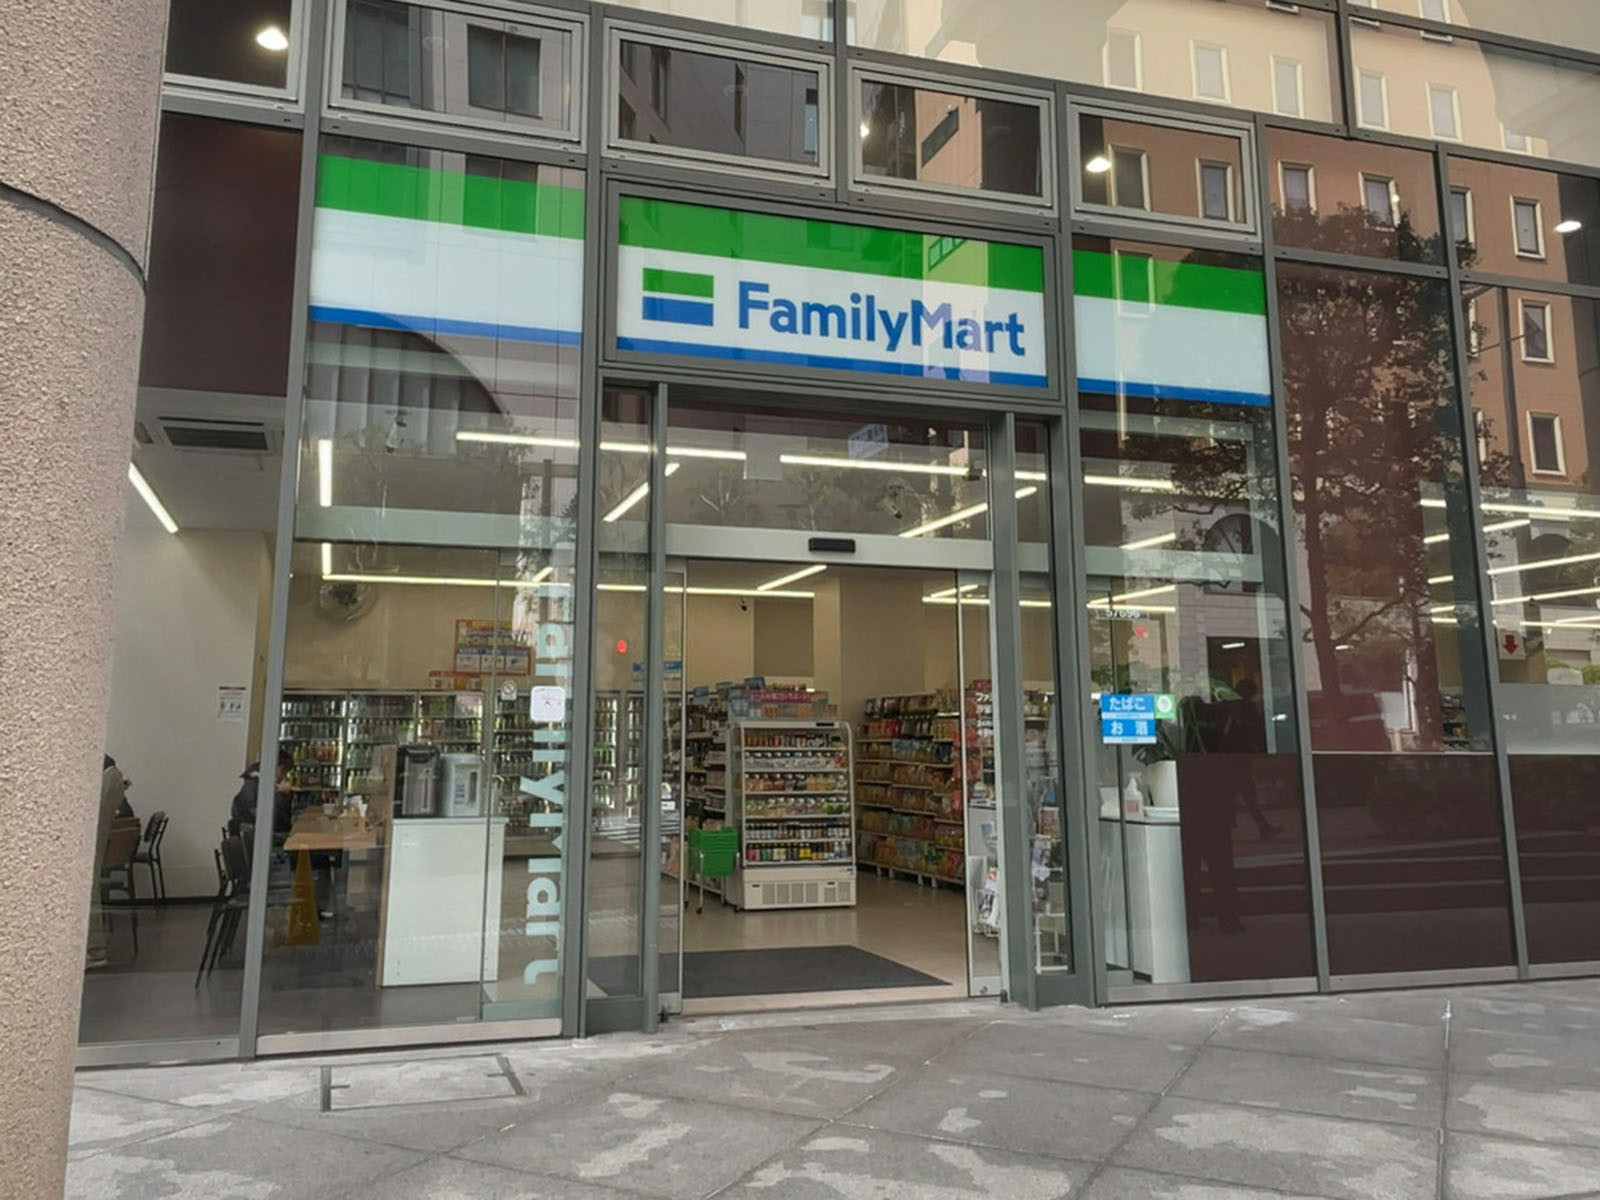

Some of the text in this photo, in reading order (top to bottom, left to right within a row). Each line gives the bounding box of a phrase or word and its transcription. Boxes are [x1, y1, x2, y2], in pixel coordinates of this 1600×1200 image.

[738, 281, 1026, 356] FamilyMart
[1109, 695, 1146, 711] たばこ
